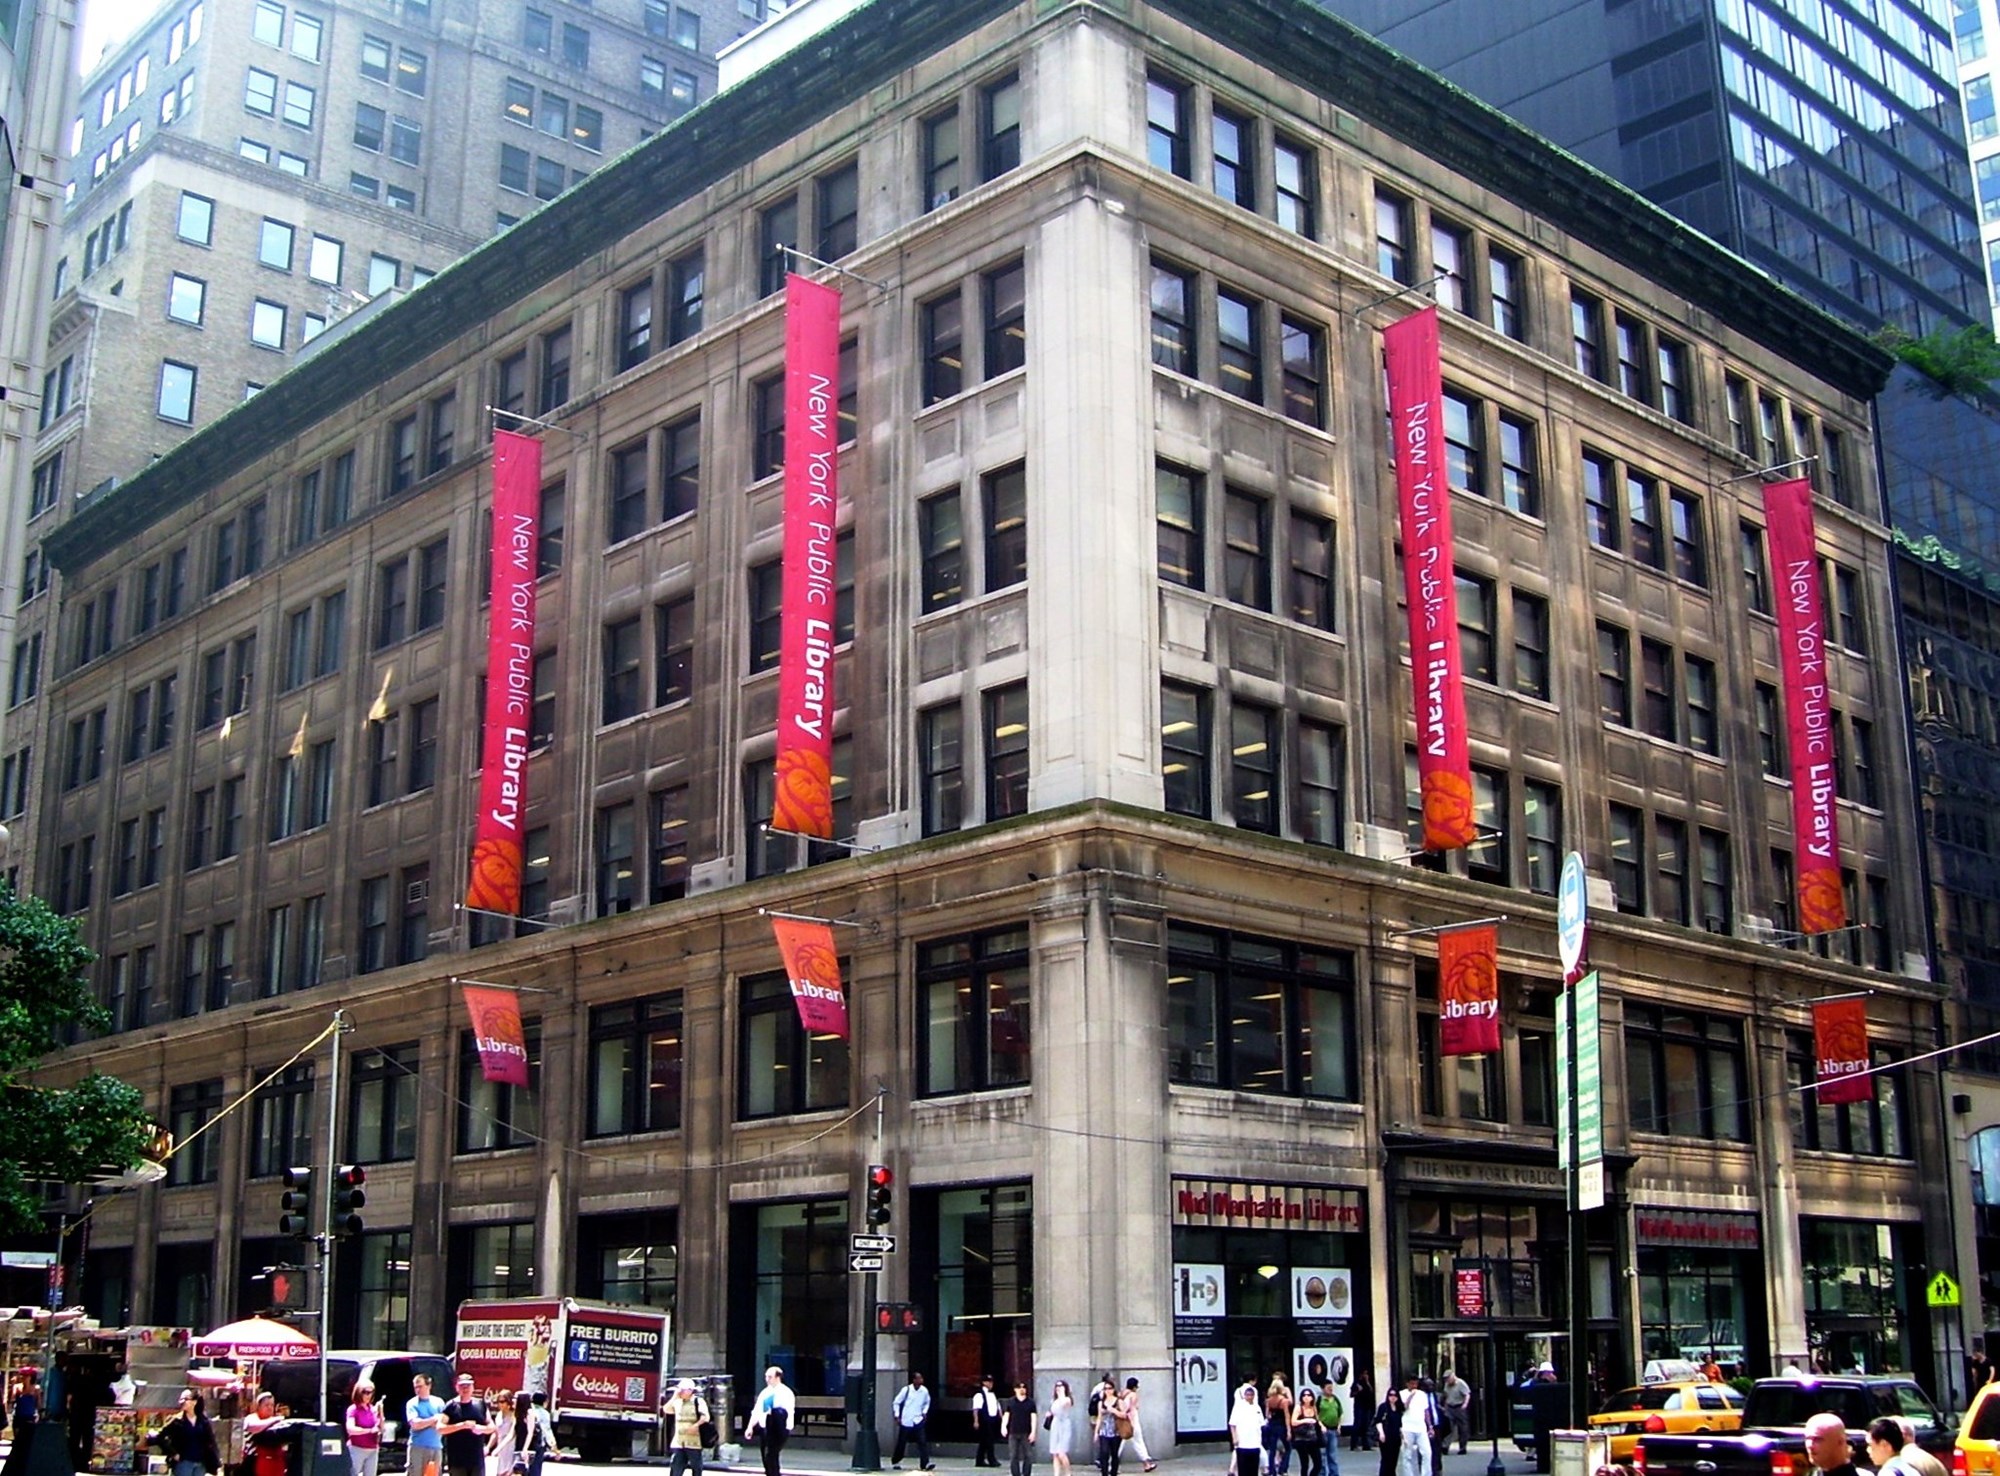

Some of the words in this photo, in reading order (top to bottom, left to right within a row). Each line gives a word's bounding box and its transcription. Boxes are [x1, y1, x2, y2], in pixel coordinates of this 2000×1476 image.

[809, 373, 832, 439] New
[1406, 401, 1428, 464] New
[808, 451, 833, 509] York
[511, 513, 534, 570] New
[806, 521, 832, 605] Public
[510, 581, 532, 631] York
[1789, 560, 1811, 613] New
[1797, 622, 1822, 673] York
[507, 643, 530, 714] Public
[794, 618, 830, 740] Library
[1804, 685, 1829, 753] Public
[492, 727, 526, 830] Library
[1808, 763, 1832, 858] Library
[1816, 1058, 1870, 1076] Library
[1413, 1161, 1438, 1177] THE
[1446, 1165, 1471, 1180] NEW
[1478, 1169, 1507, 1182] YORK
[1514, 1169, 1556, 1185] PUBLIC
[1178, 1190, 1208, 1215] Mid
[1213, 1192, 1301, 1221] Manhattan
[1308, 1197, 1361, 1227] Library
[460, 1348, 484, 1360] QDOBA
[485, 1348, 522, 1360] DELIVERS!
[462, 1325, 474, 1338] WHY
[475, 1325, 492, 1338] LEAVE
[492, 1324, 503, 1337] THE
[569, 1324, 603, 1340] FREE
[604, 1328, 658, 1345] BURRITO
[572, 1373, 620, 1396] Qdoba
